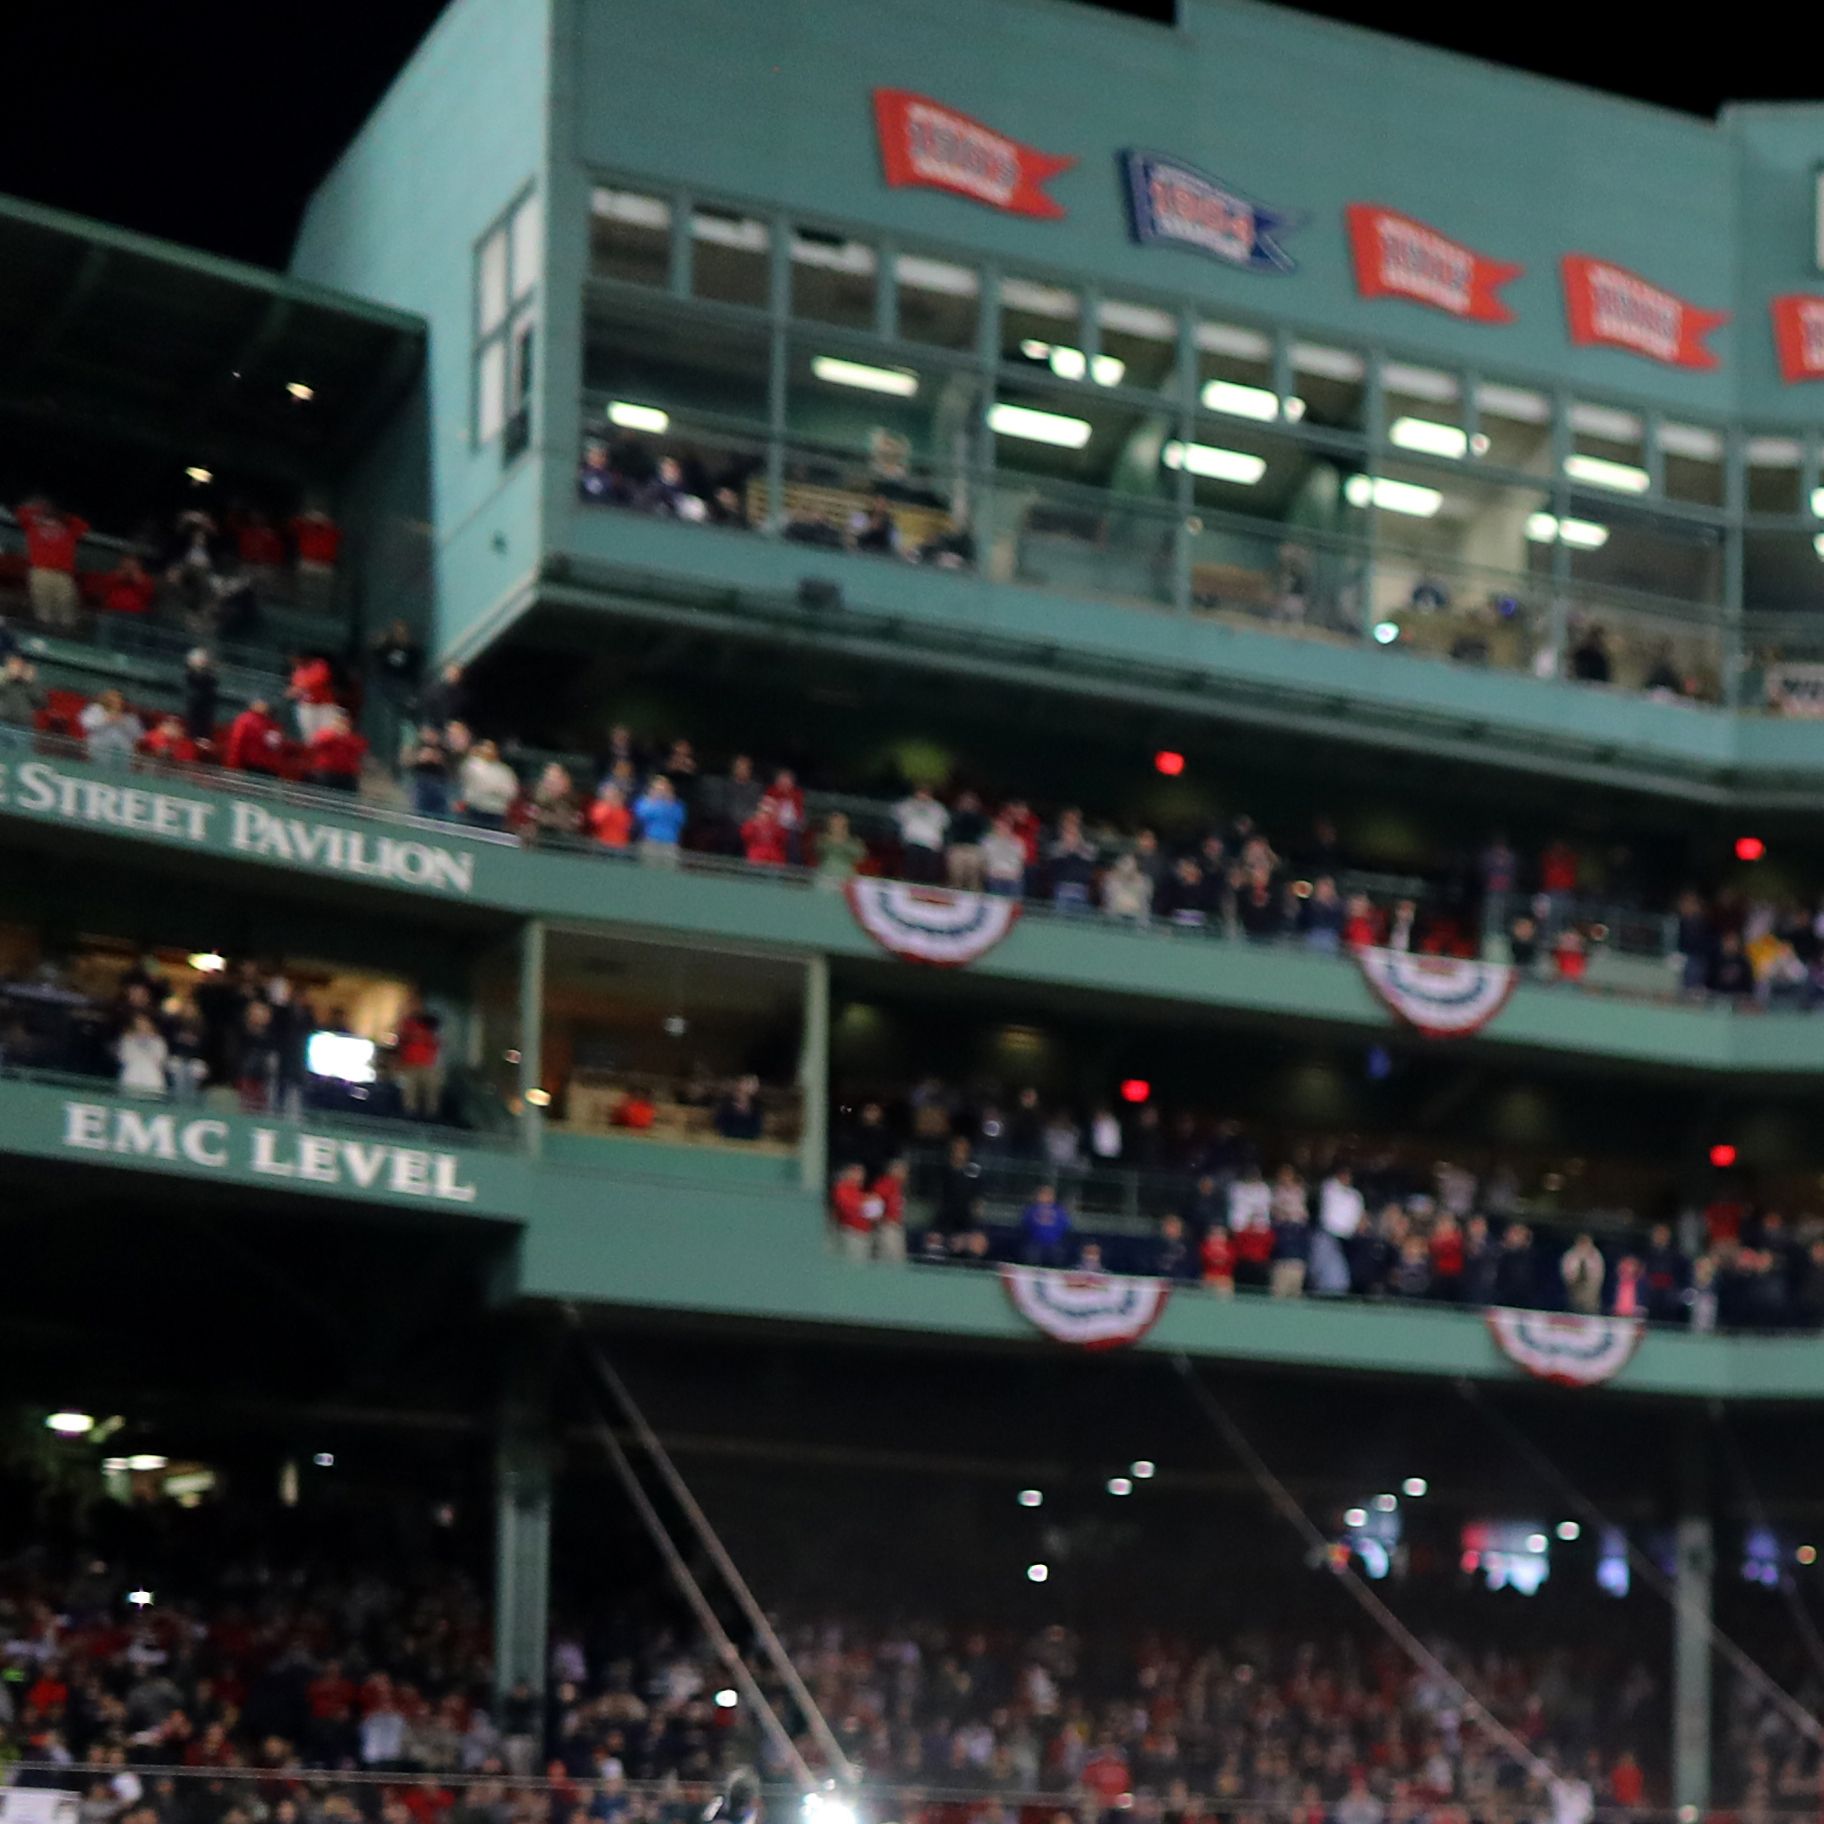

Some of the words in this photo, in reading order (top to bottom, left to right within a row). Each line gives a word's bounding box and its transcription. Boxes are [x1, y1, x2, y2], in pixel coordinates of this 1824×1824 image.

[17, 762, 215, 841] STREET
[231, 802, 472, 891] PAVILION
[63, 1101, 230, 1167] EMC
[250, 1127, 478, 1203] LEVEL
